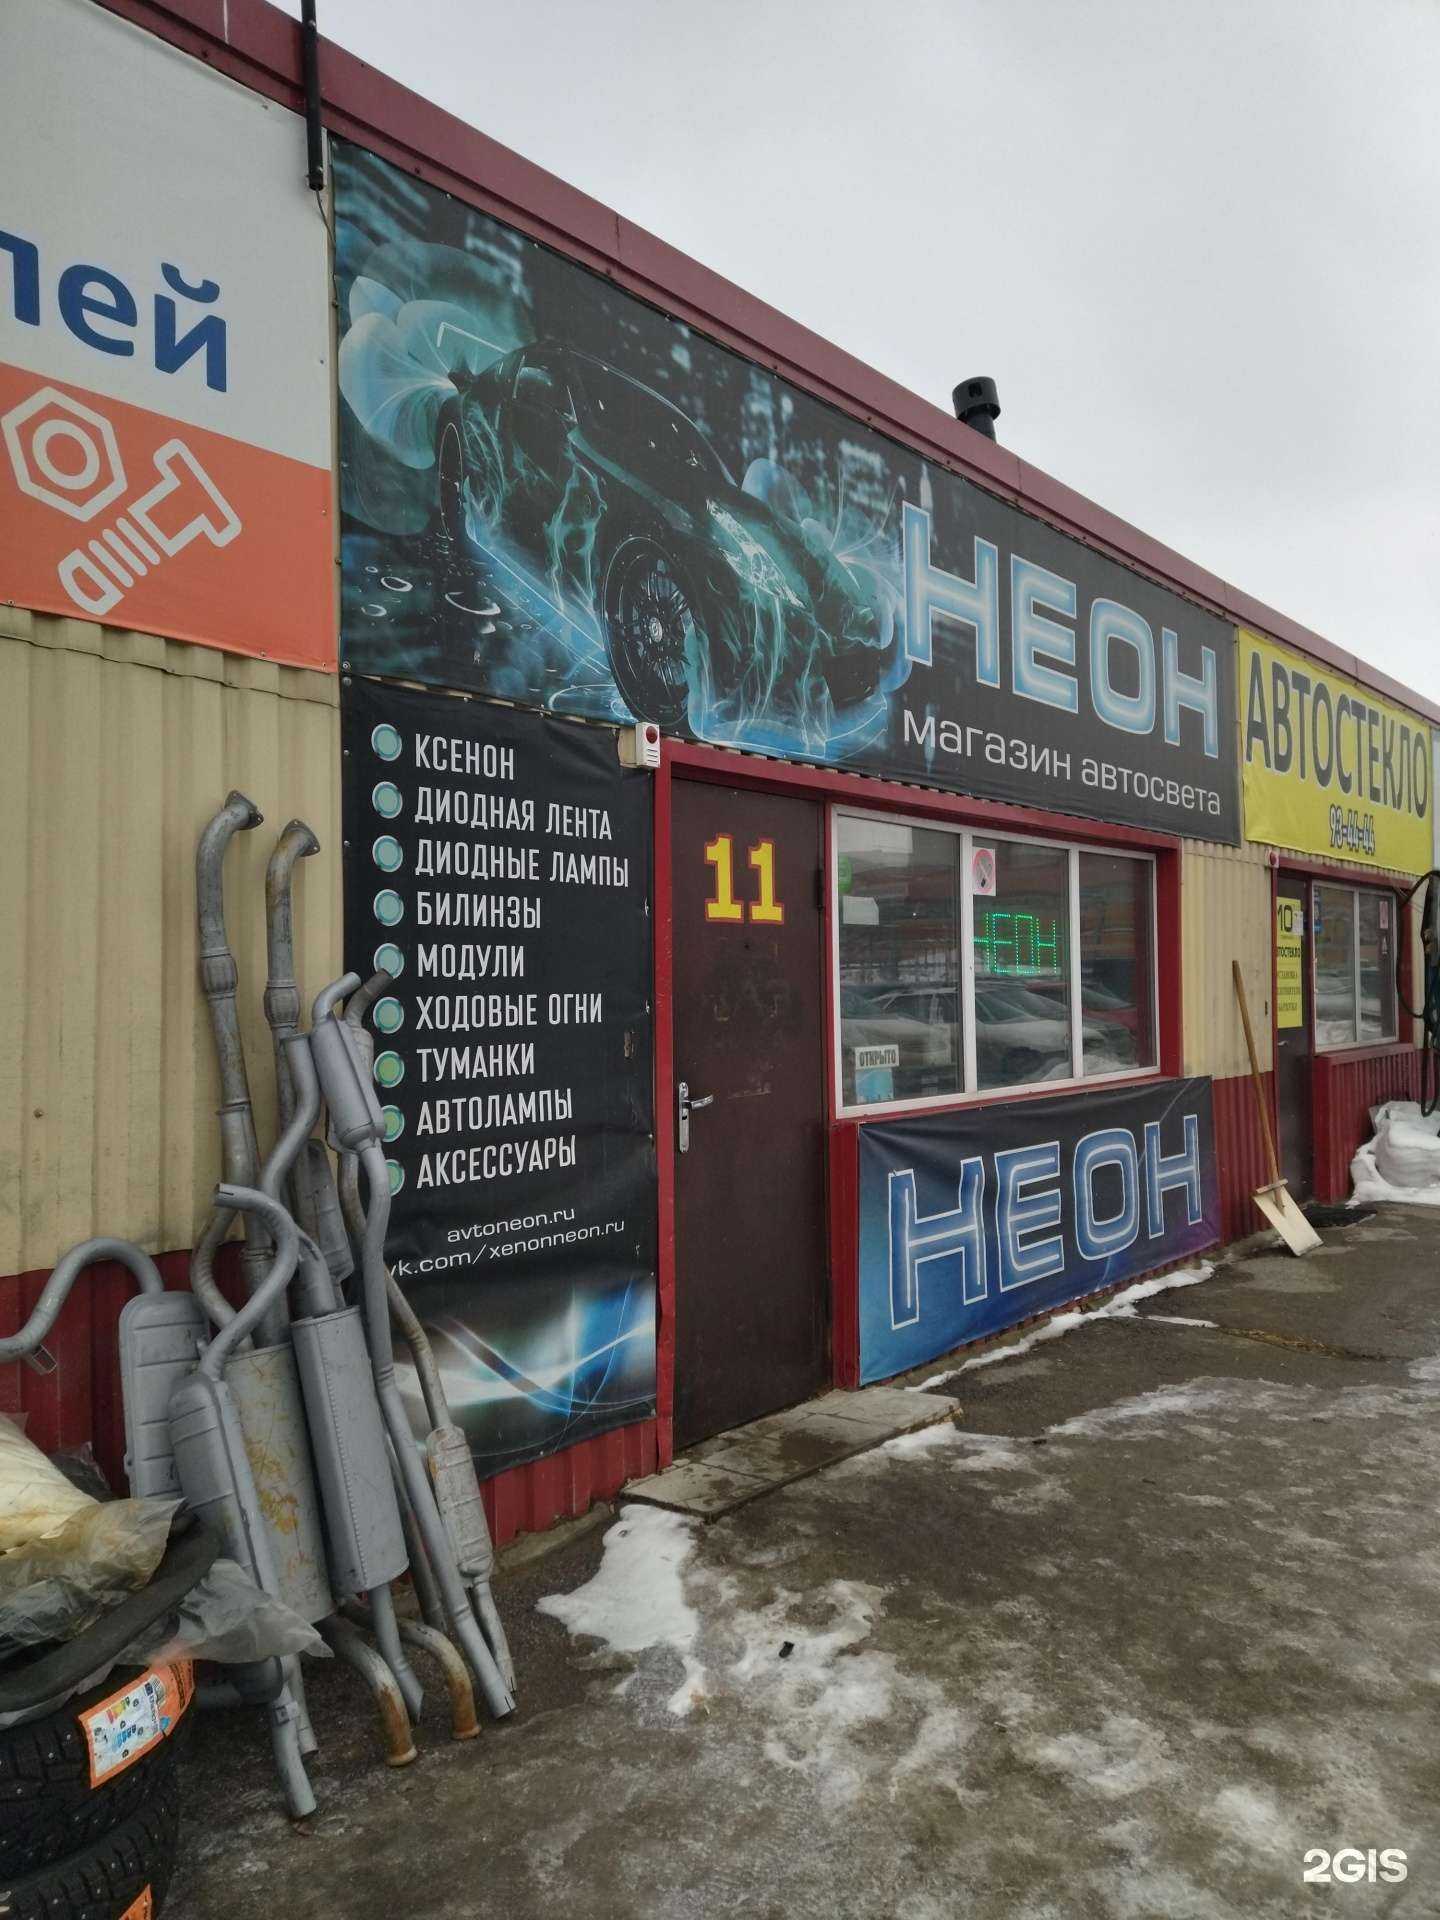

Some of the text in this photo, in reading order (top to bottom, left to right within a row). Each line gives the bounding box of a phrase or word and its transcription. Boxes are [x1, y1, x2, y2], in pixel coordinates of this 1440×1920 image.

[902, 500, 1219, 760] НЕОН
[415, 733, 515, 780] КСЕНОН
[1246, 651, 1428, 818] АВТОСТЕКЛО
[903, 709, 1221, 816] Магазин автосвета
[414, 786, 613, 841] ДИОДНАЯ ЛЕНТА
[414, 838, 630, 888] ДИОДНЫЕ ЛАМПЫ
[704, 833, 785, 924] 11
[416, 891, 541, 929] БИЛИНЗЫ
[416, 943, 525, 981] МОДУЛИ
[415, 992, 603, 1032] ХОДОВЫЕ ОГНИ
[416, 1042, 536, 1083] ТУМАНКИ
[859, 1049, 897, 1067] ОТКРЫТО
[416, 1087, 574, 1136] АВТОЛАМПЫ
[416, 1134, 577, 1189] АКСЕССУАРЫ
[446, 1207, 576, 1243] avtoneon.ru
[888, 1114, 1202, 1330] НЕОН
